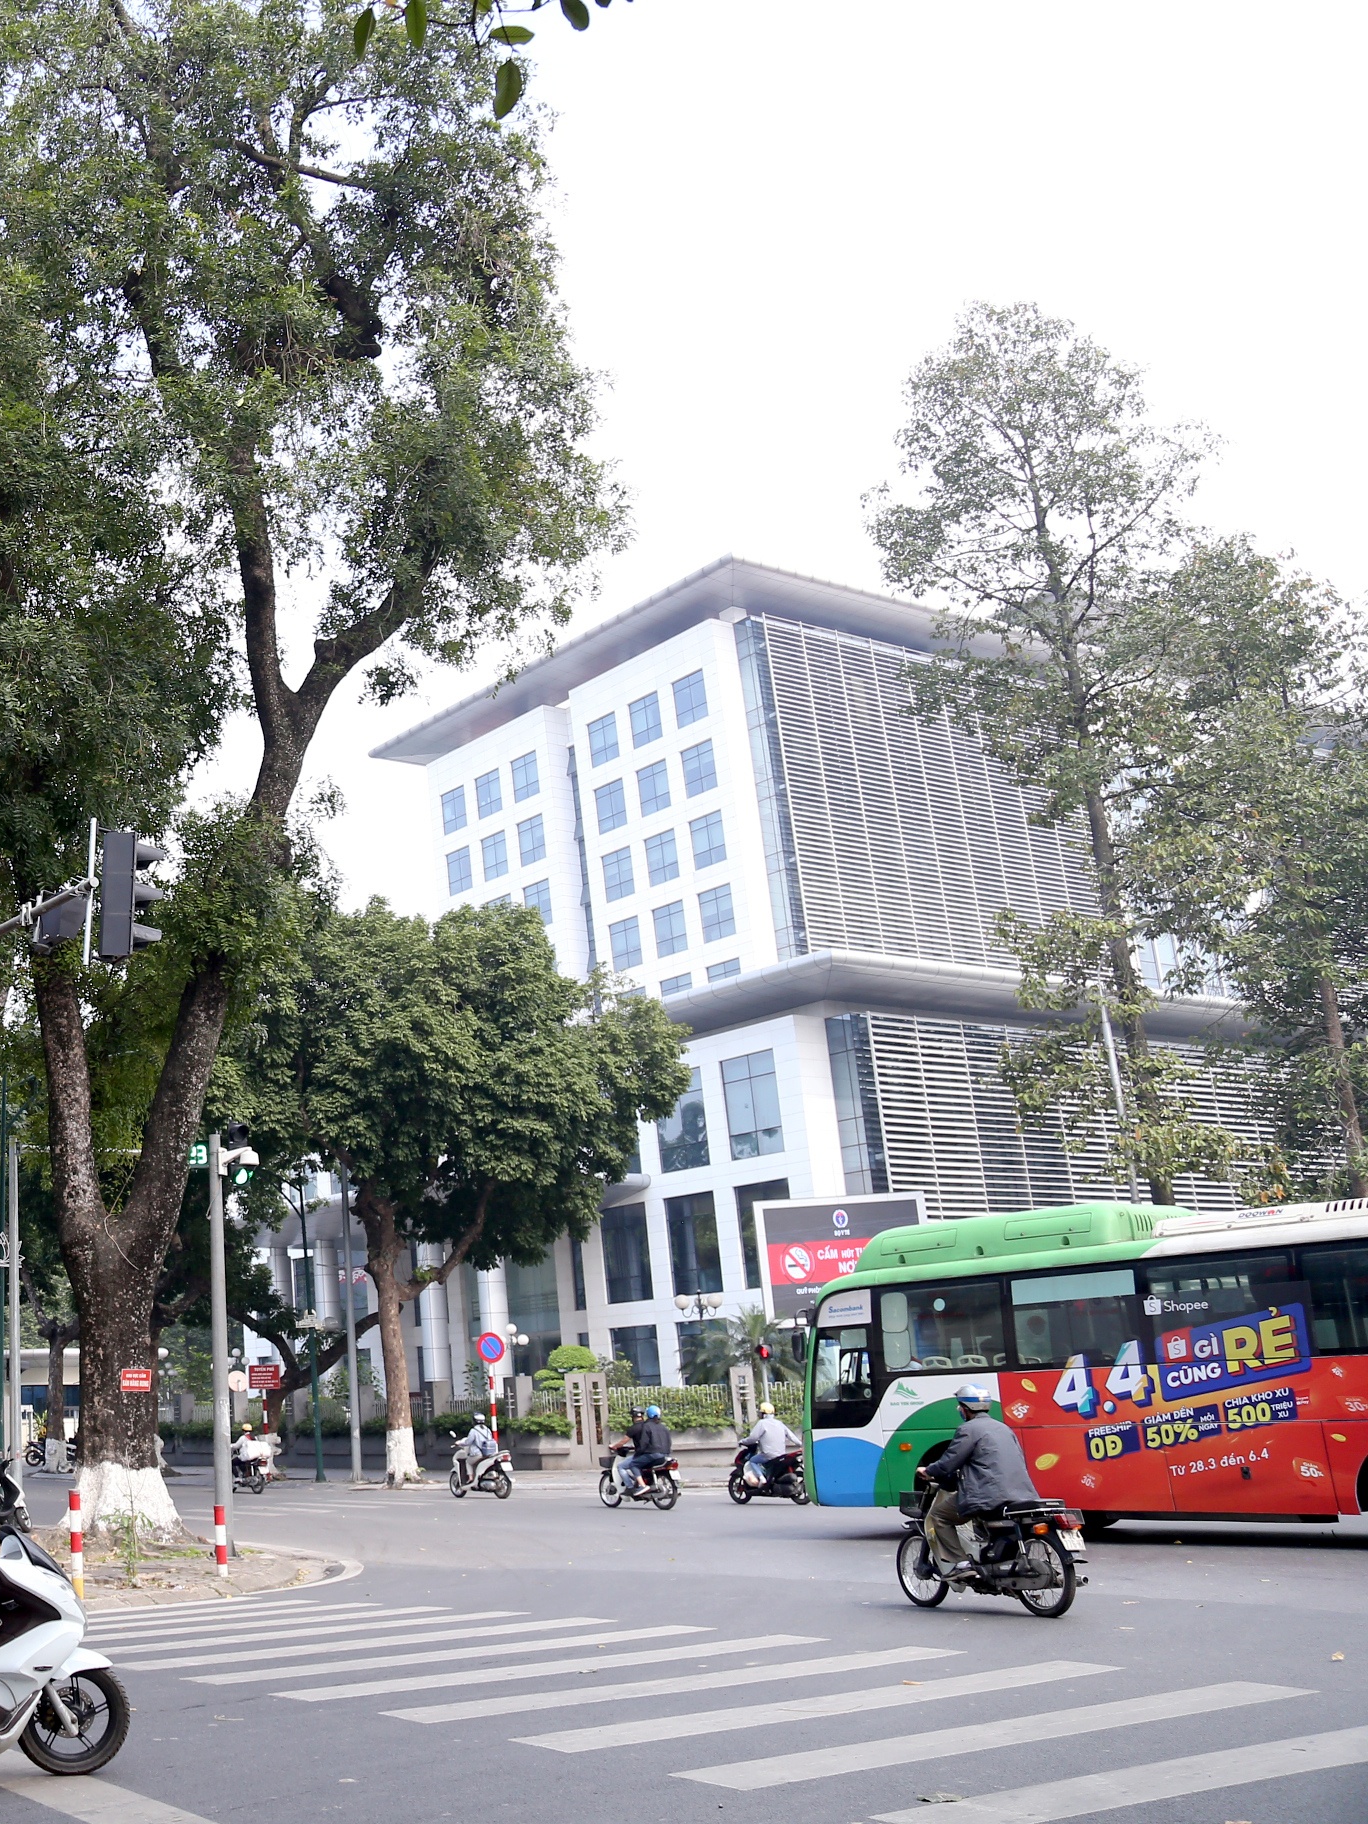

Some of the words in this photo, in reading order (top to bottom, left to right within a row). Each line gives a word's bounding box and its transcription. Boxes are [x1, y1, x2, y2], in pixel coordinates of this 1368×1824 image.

[817, 1245, 838, 1260] CẤM
[828, 1304, 863, 1313] Sacombank
[1163, 1300, 1209, 1313] Shopee
[1194, 1333, 1219, 1358] GÌ
[1222, 1306, 1295, 1373] RẺ
[1052, 1340, 1150, 1414] 4.4
[1166, 1362, 1222, 1388] CŨNG
[1225, 1396, 1249, 1408] CHIA
[1252, 1391, 1272, 1402] KHO
[1274, 1387, 1289, 1397] XU
[1144, 1411, 1171, 1425] GIẢM
[1173, 1406, 1194, 1419] ĐẾN
[1228, 1402, 1271, 1429] 500
[1271, 1401, 1293, 1411] TRIỆU
[1278, 1410, 1289, 1419] XU
[1088, 1421, 1132, 1437] FREESHIP
[1147, 1418, 1198, 1448] 50%
[1169, 1463, 1185, 1476] Từ
[1189, 1458, 1216, 1473] 28.3
[1220, 1453, 1245, 1467] đến
[1248, 1448, 1269, 1461] 6.4
[1300, 1465, 1324, 1478] 50%
